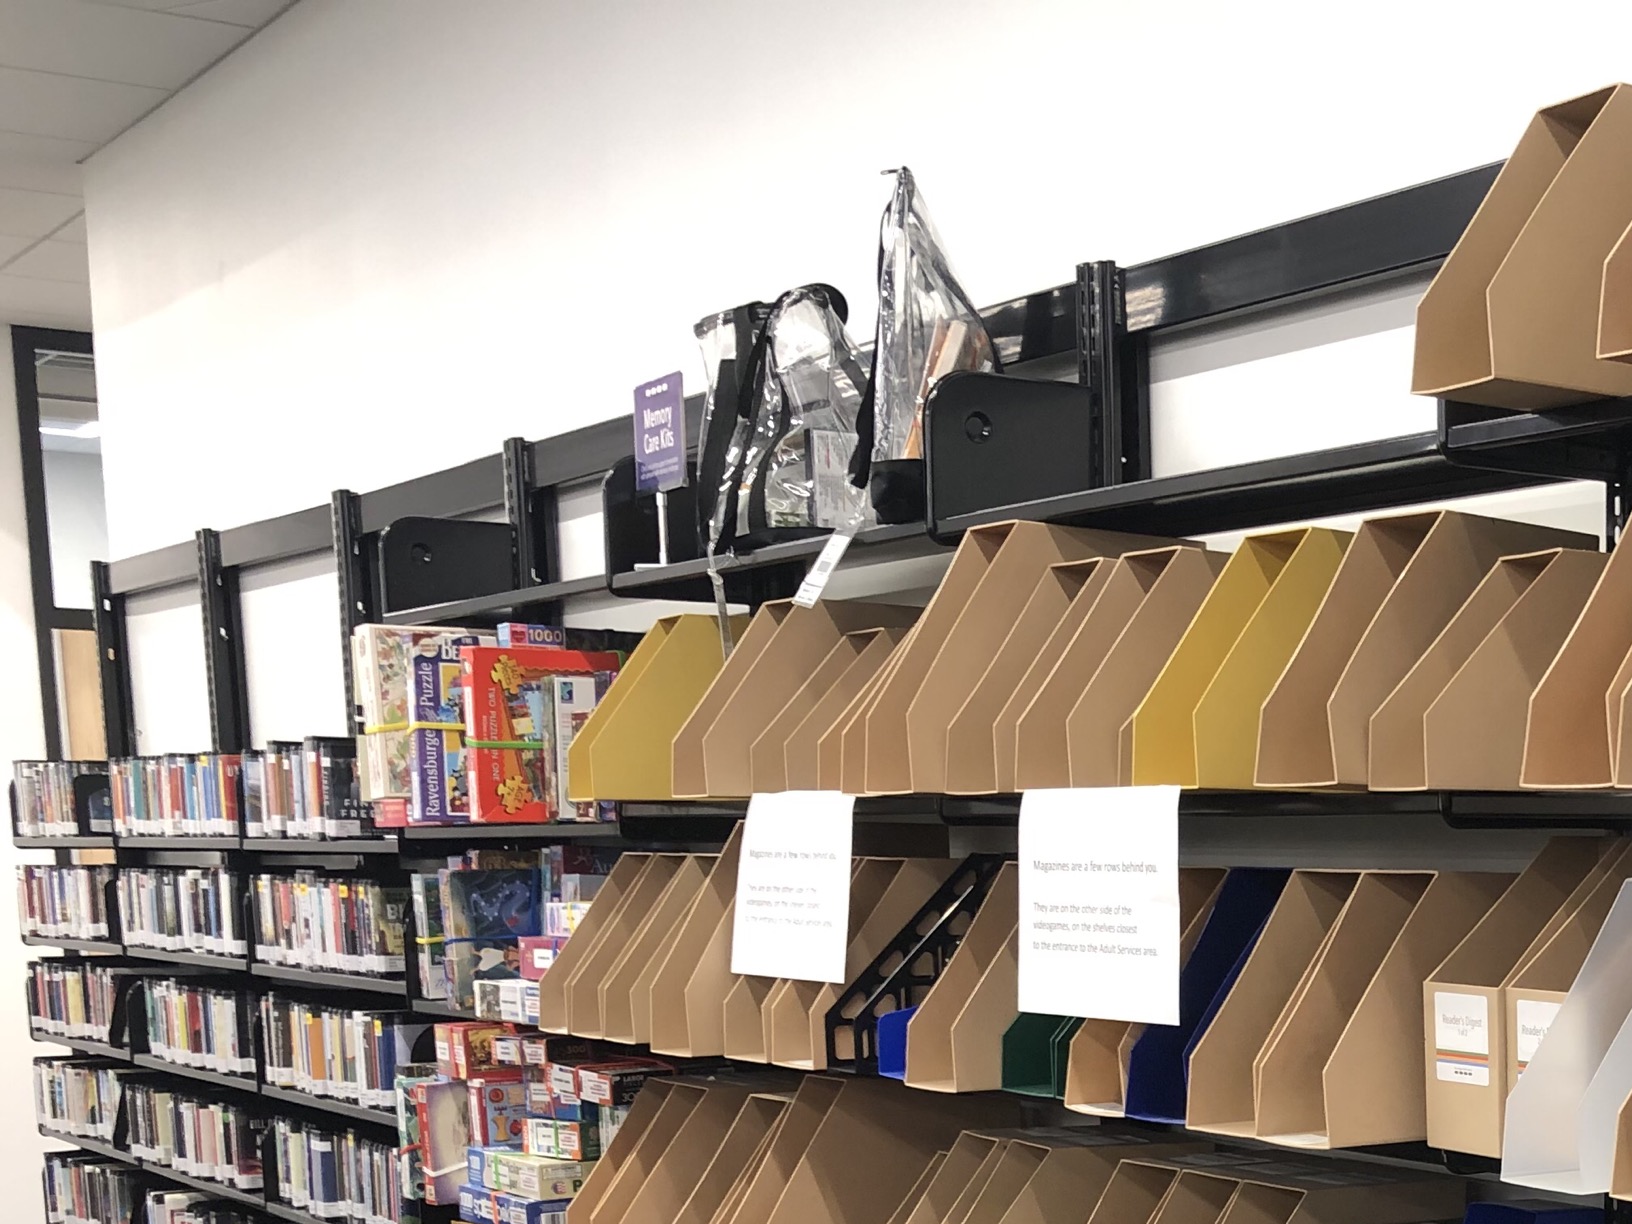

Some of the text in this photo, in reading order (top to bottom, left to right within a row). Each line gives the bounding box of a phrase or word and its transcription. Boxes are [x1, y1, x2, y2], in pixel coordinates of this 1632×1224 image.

[643, 406, 672, 430] Memory
[644, 429, 674, 454] Care Kits
[529, 629, 562, 642] 1000
[488, 688, 496, 707] TWO
[489, 711, 498, 741] PUZZLE
[418, 663, 440, 816] Ravensburge Puzzle
[492, 762, 500, 781] ONE
[1033, 860, 1069, 873] Magazines
[1071, 863, 1082, 871] are
[1090, 861, 1102, 872] few
[1104, 863, 1120, 872] rows
[1122, 862, 1143, 873] behind
[1145, 865, 1158, 874] you.
[1033, 903, 1047, 915] They
[1070, 904, 1079, 913] the
[1081, 905, 1098, 914] other
[1100, 905, 1112, 915] side
[1114, 905, 1121, 915] of
[1122, 906, 1131, 916] the
[1033, 921, 1070, 933] videogames,
[1081, 923, 1091, 932] the
[1093, 924, 1115, 933] shelves
[1117, 925, 1137, 934] closest
[1033, 941, 1039, 949] to
[1041, 942, 1050, 950] the
[1052, 943, 1077, 952] entrance
[1080, 944, 1086, 953] to
[1087, 944, 1098, 953] the
[1100, 944, 1116, 954] Adult
[1117, 946, 1141, 955] Services
[1442, 1014, 1482, 1029] Reader's Digest
